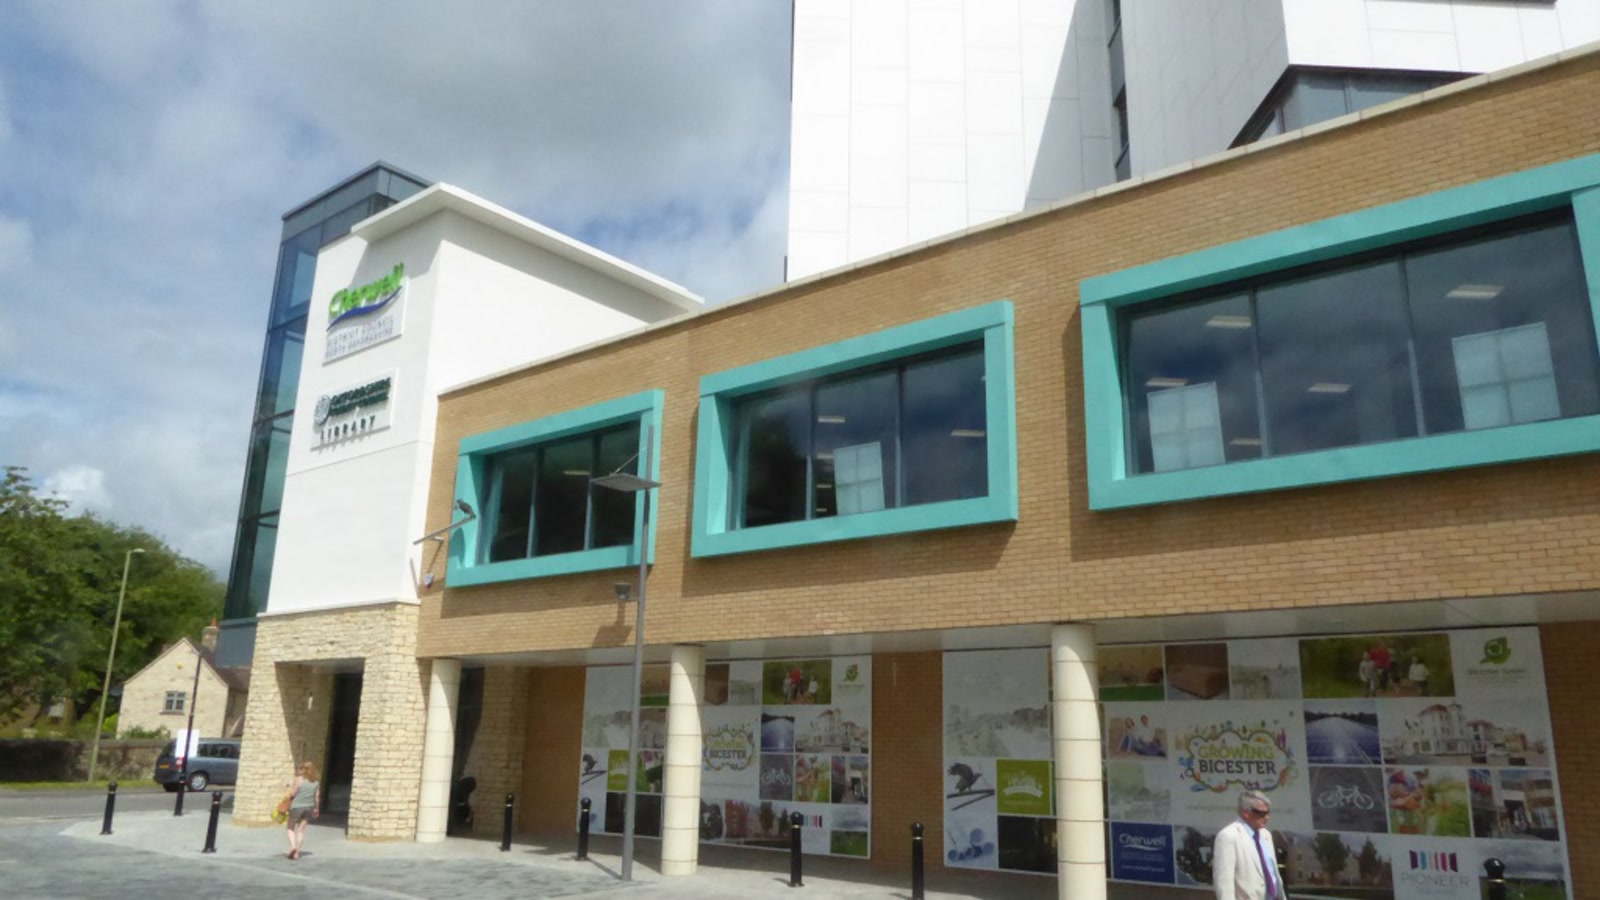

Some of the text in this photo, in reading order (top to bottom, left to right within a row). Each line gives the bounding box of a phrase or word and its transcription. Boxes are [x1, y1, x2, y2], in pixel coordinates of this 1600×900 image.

[320, 415, 376, 440] LIBRARY
[1198, 743, 1274, 759] GROWING
[1199, 759, 1277, 775] BICESTER
[1119, 833, 1167, 847] Cherwell
[1401, 872, 1471, 888] PIONEER
